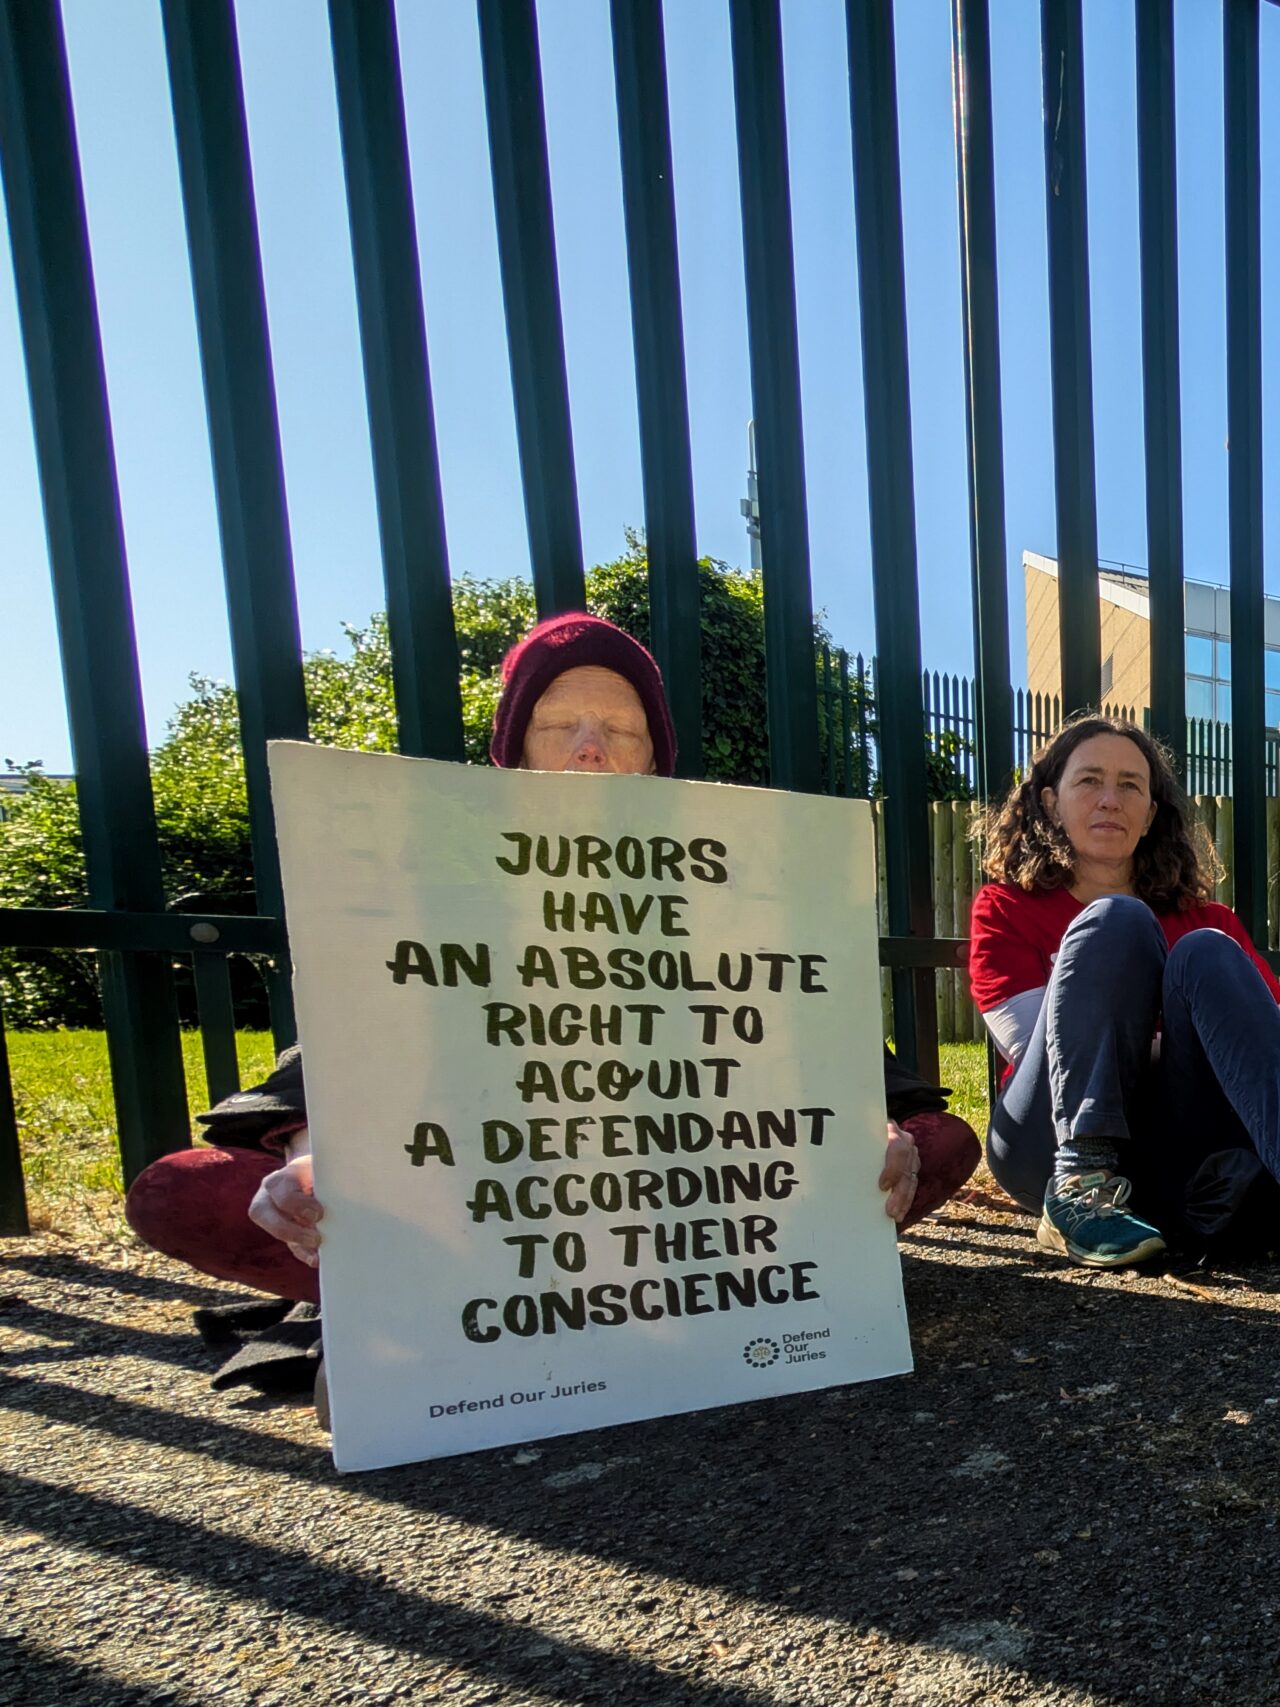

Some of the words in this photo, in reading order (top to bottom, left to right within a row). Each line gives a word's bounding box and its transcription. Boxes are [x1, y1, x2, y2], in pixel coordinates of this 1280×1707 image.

[495, 831, 728, 884] JURORS
[543, 890, 690, 937] HAVE
[385, 940, 490, 987] AN
[516, 948, 828, 994] ABSOLUTE
[482, 1003, 664, 1047] RIGHT
[690, 1005, 763, 1045] TO
[515, 1058, 741, 1104] ACQUIT
[404, 1121, 455, 1167] A
[482, 1107, 835, 1164] DEFENDANT
[466, 1161, 799, 1224] ACCORDING
[503, 1231, 586, 1279] TO
[609, 1215, 778, 1268] THEIR
[461, 1261, 820, 1344] CONSCIENCE
[782, 1328, 831, 1344] Defend
[784, 1342, 809, 1354] Our
[784, 1350, 826, 1365] Juries
[429, 1395, 504, 1419] Defend
[510, 1388, 547, 1405] Our
[550, 1379, 607, 1399] Juries
